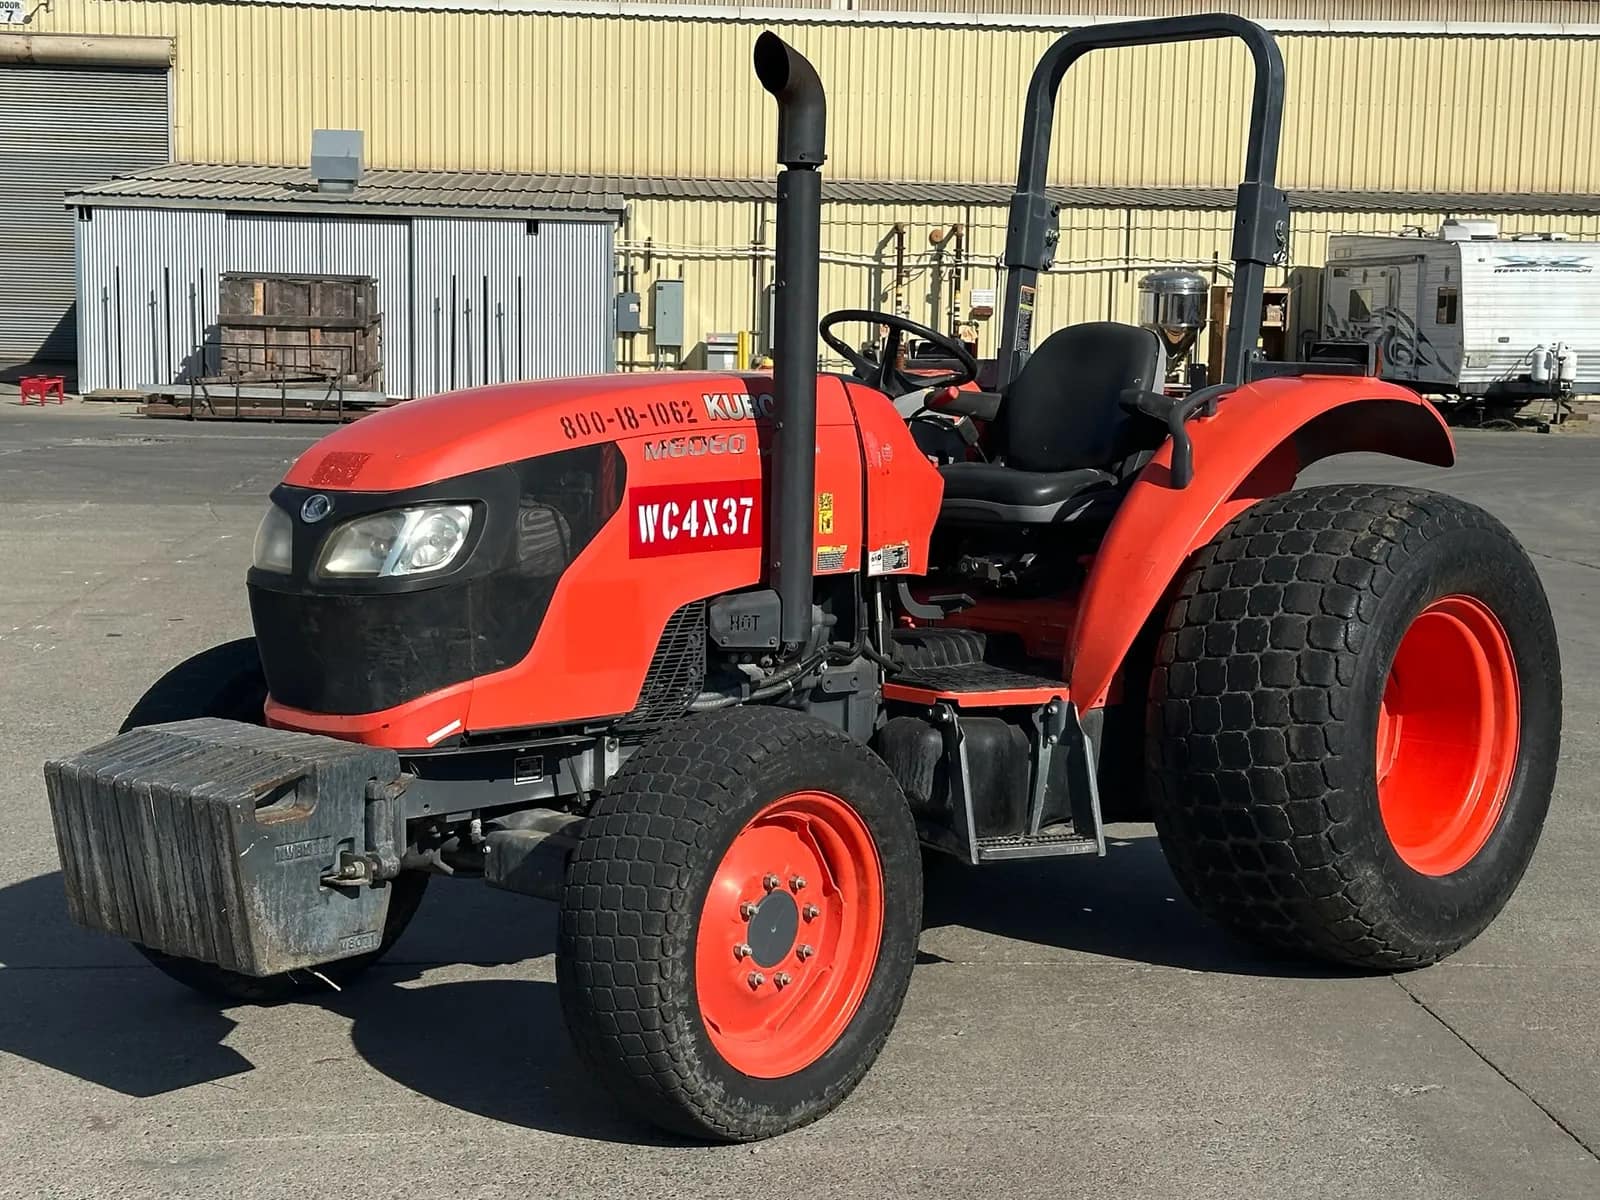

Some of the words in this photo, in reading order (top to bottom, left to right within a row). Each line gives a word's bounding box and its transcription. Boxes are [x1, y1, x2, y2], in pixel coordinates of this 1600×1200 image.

[5, 10, 14, 22] 7
[560, 400, 699, 440] 800-18-1062
[701, 393, 774, 421] KUBO
[638, 497, 754, 544] WC4X37
[729, 614, 761, 633] HOT
